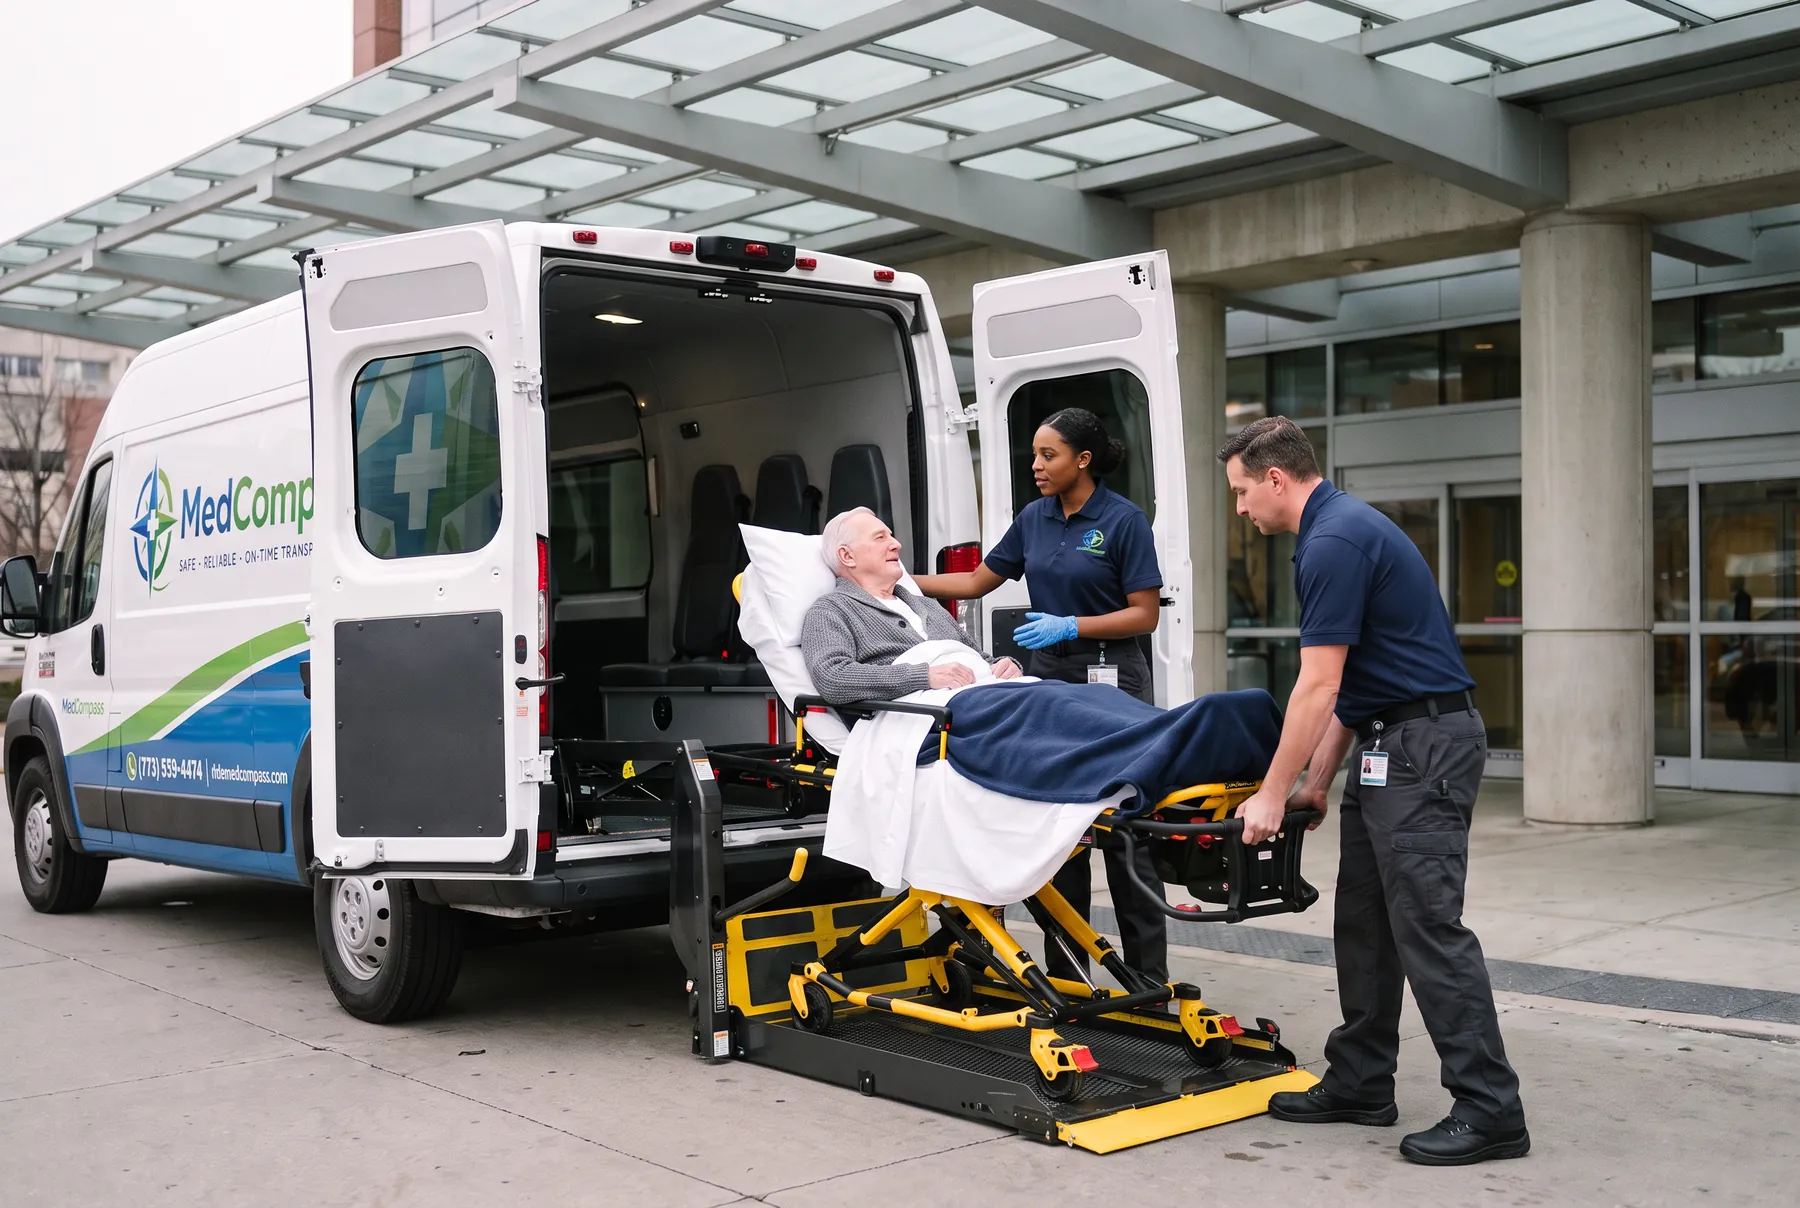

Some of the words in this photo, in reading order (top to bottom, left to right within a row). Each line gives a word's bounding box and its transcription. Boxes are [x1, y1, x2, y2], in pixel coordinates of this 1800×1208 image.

[180, 475, 314, 540] MedComp
[179, 557, 196, 572] SAFE
[203, 552, 237, 569] RELIABLE
[244, 546, 279, 564] ON-TIME
[281, 542, 314, 559] TRANSP
[138, 755, 160, 781] (773)
[161, 757, 203, 781] 559-4474
